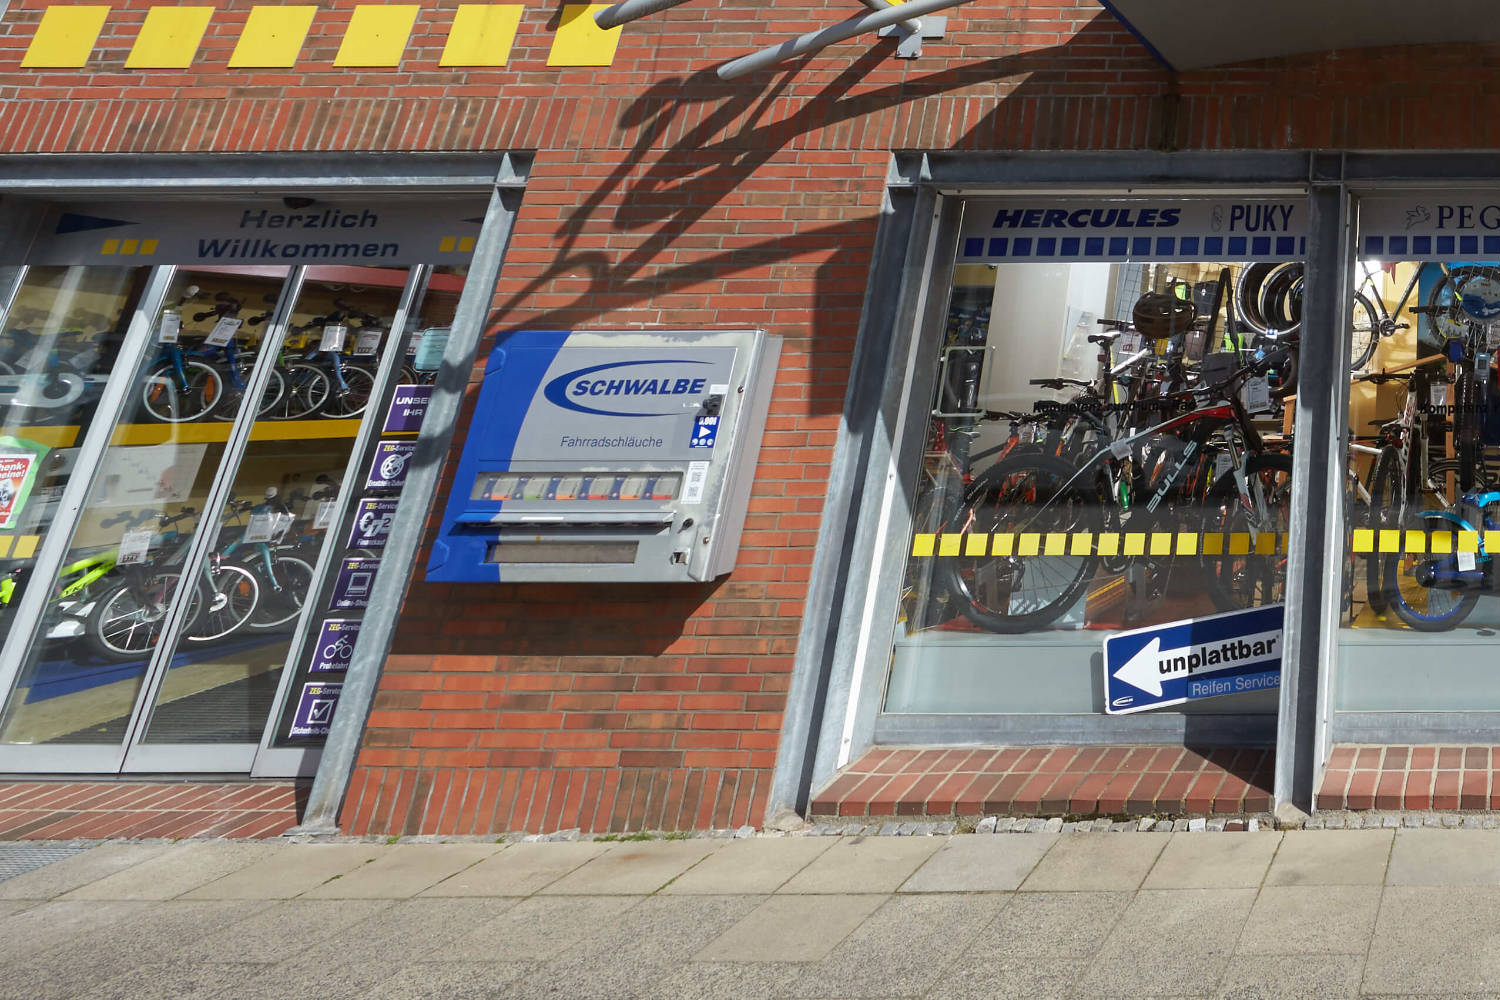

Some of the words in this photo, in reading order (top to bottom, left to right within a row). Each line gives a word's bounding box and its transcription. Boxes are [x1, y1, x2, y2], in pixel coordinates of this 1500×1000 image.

[239, 209, 378, 229] Herzlich
[992, 208, 1181, 228] HERCULES
[1229, 204, 1295, 232] PUKY
[198, 238, 399, 258] Willkommen
[572, 378, 707, 396] SCHWALBE
[396, 397, 431, 405] UNSE
[560, 436, 663, 448] Fahrradschläuche
[1146, 440, 1197, 513] BULLS
[1158, 636, 1277, 674] unplattbar
[1192, 680, 1231, 696] Reifen
[1235, 674, 1281, 690] Service
